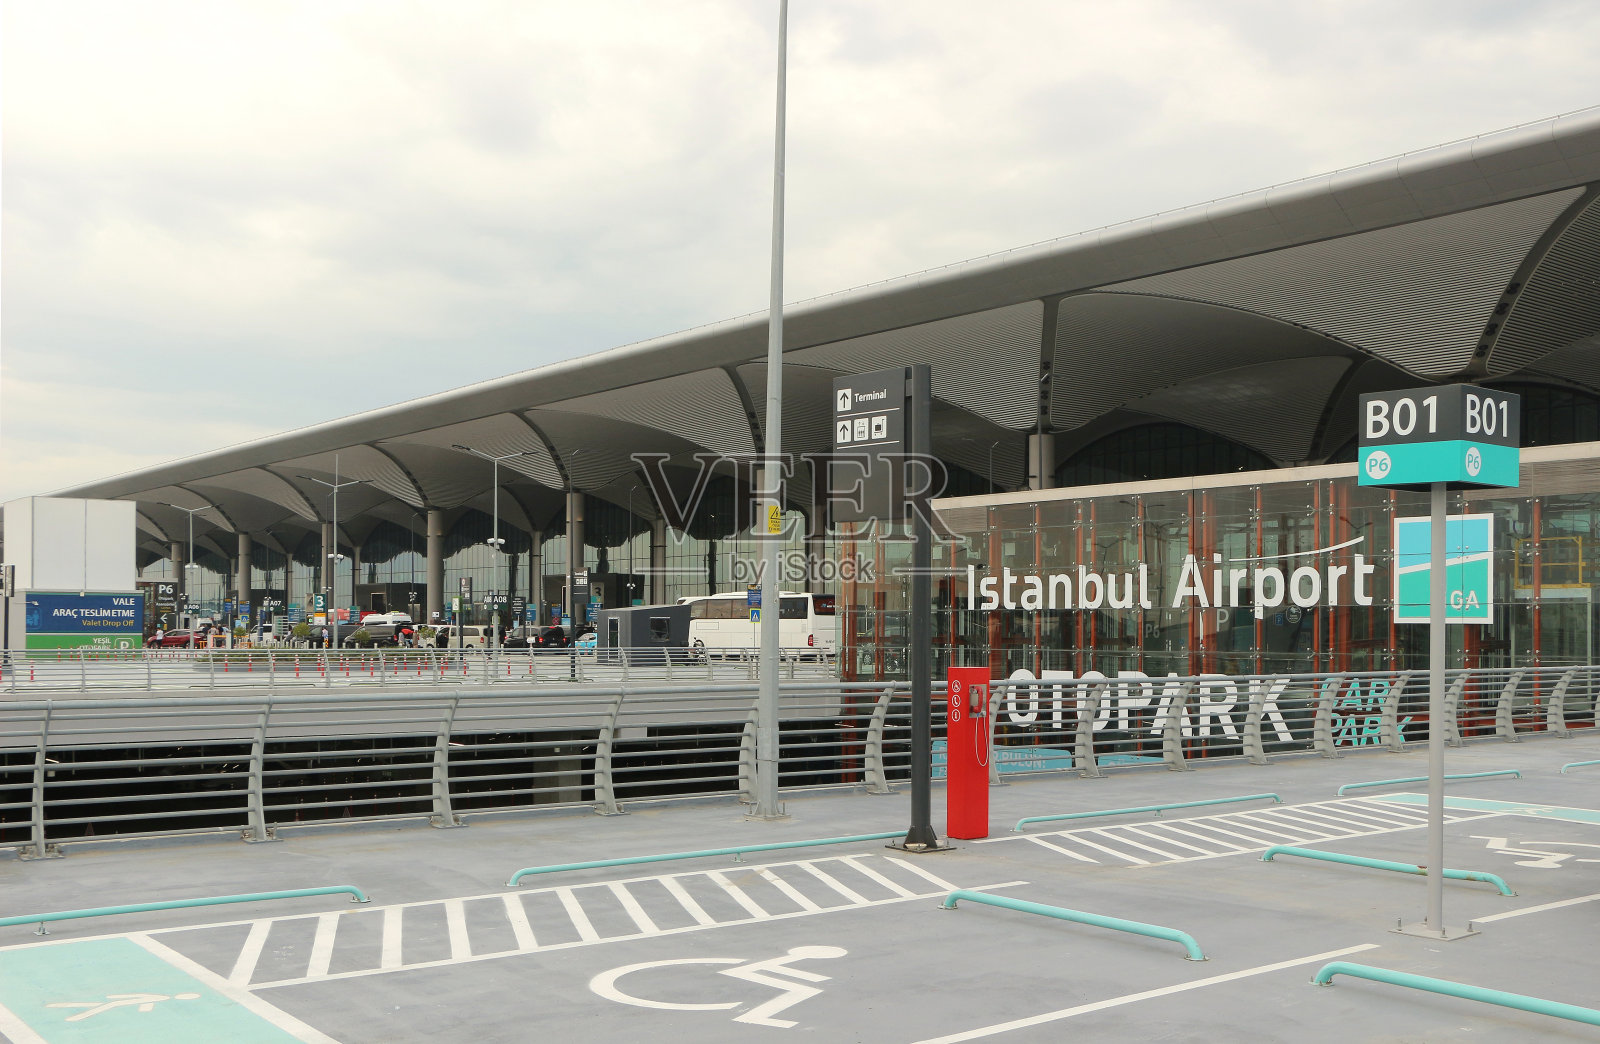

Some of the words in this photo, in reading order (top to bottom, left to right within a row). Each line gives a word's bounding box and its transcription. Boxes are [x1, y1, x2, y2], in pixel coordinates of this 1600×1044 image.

[854, 388, 887, 403] Terminal
[1366, 395, 1437, 439] B01
[1466, 393, 1508, 438] B01
[1368, 457, 1389, 473] P6
[1467, 453, 1480, 470] P6
[158, 584, 174, 595] P6
[967, 562, 1152, 611] Istanbul
[1172, 552, 1375, 620] Airport
[112, 597, 135, 606] VALE
[316, 595, 324, 607] 3
[494, 595, 507, 603] A08
[1450, 589, 1480, 611] GA
[52, 608, 79, 619] ARAÇ
[80, 607, 111, 617] TESLİM
[111, 609, 135, 618] ETME
[82, 619, 101, 627] Valet
[102, 619, 121, 628] Drop
[122, 619, 135, 627] Off
[1006, 668, 1294, 742] OTOPARK
